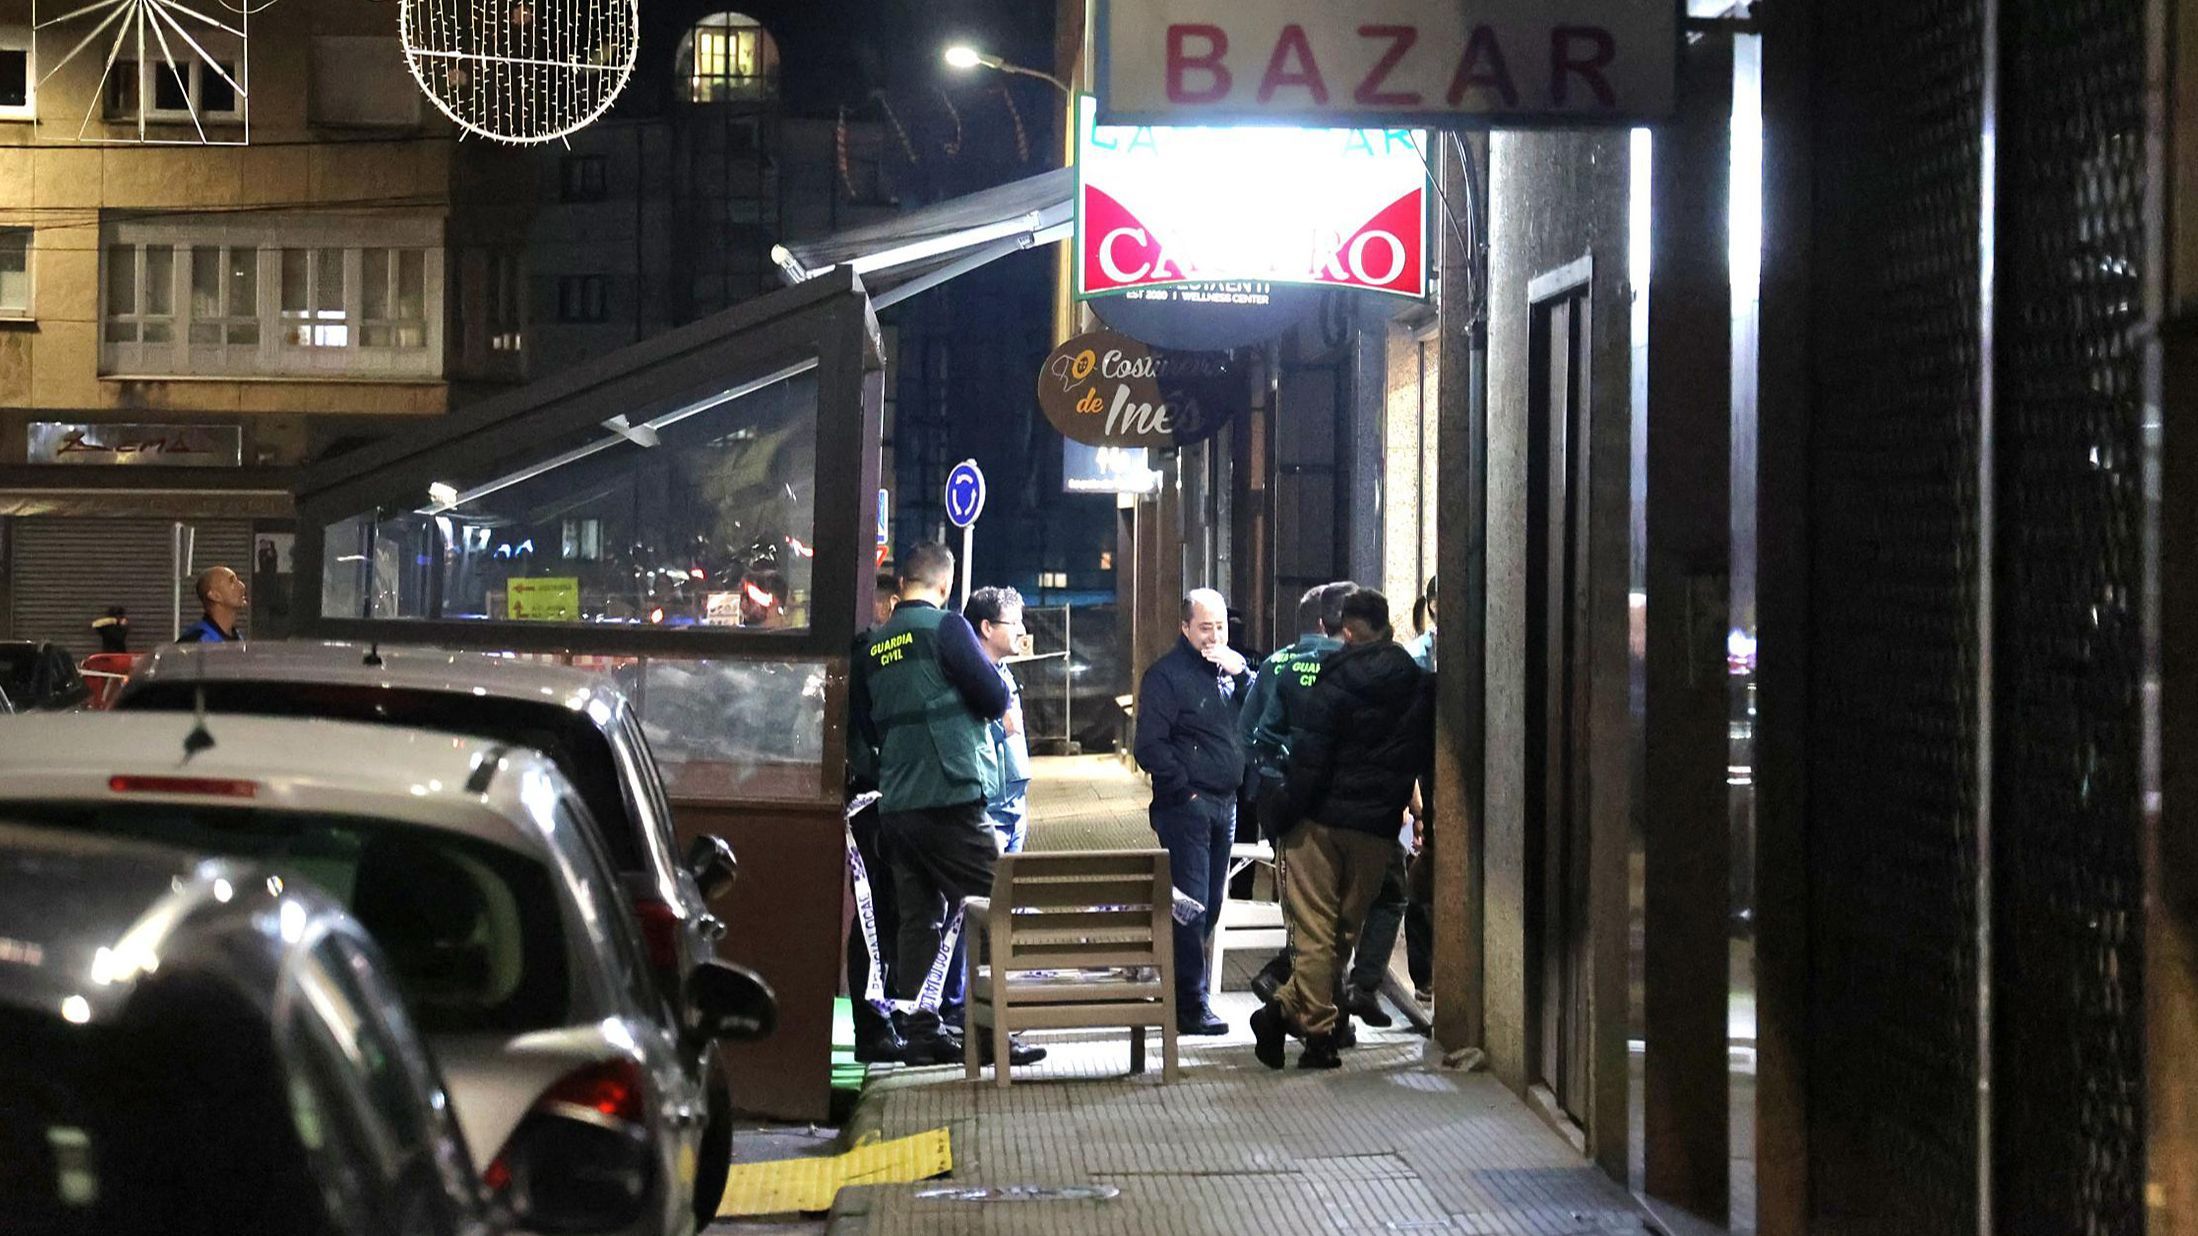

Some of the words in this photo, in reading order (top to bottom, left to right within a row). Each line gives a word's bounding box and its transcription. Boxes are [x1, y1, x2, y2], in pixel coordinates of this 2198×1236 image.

[1165, 23, 1618, 106] BAZAR
[1099, 227, 1406, 286] CARO
[1181, 292, 1231, 303] WELLNESS
[1231, 293, 1270, 304] CENTER
[1076, 387, 1103, 414] de
[870, 631, 913, 657] GUARDIA
